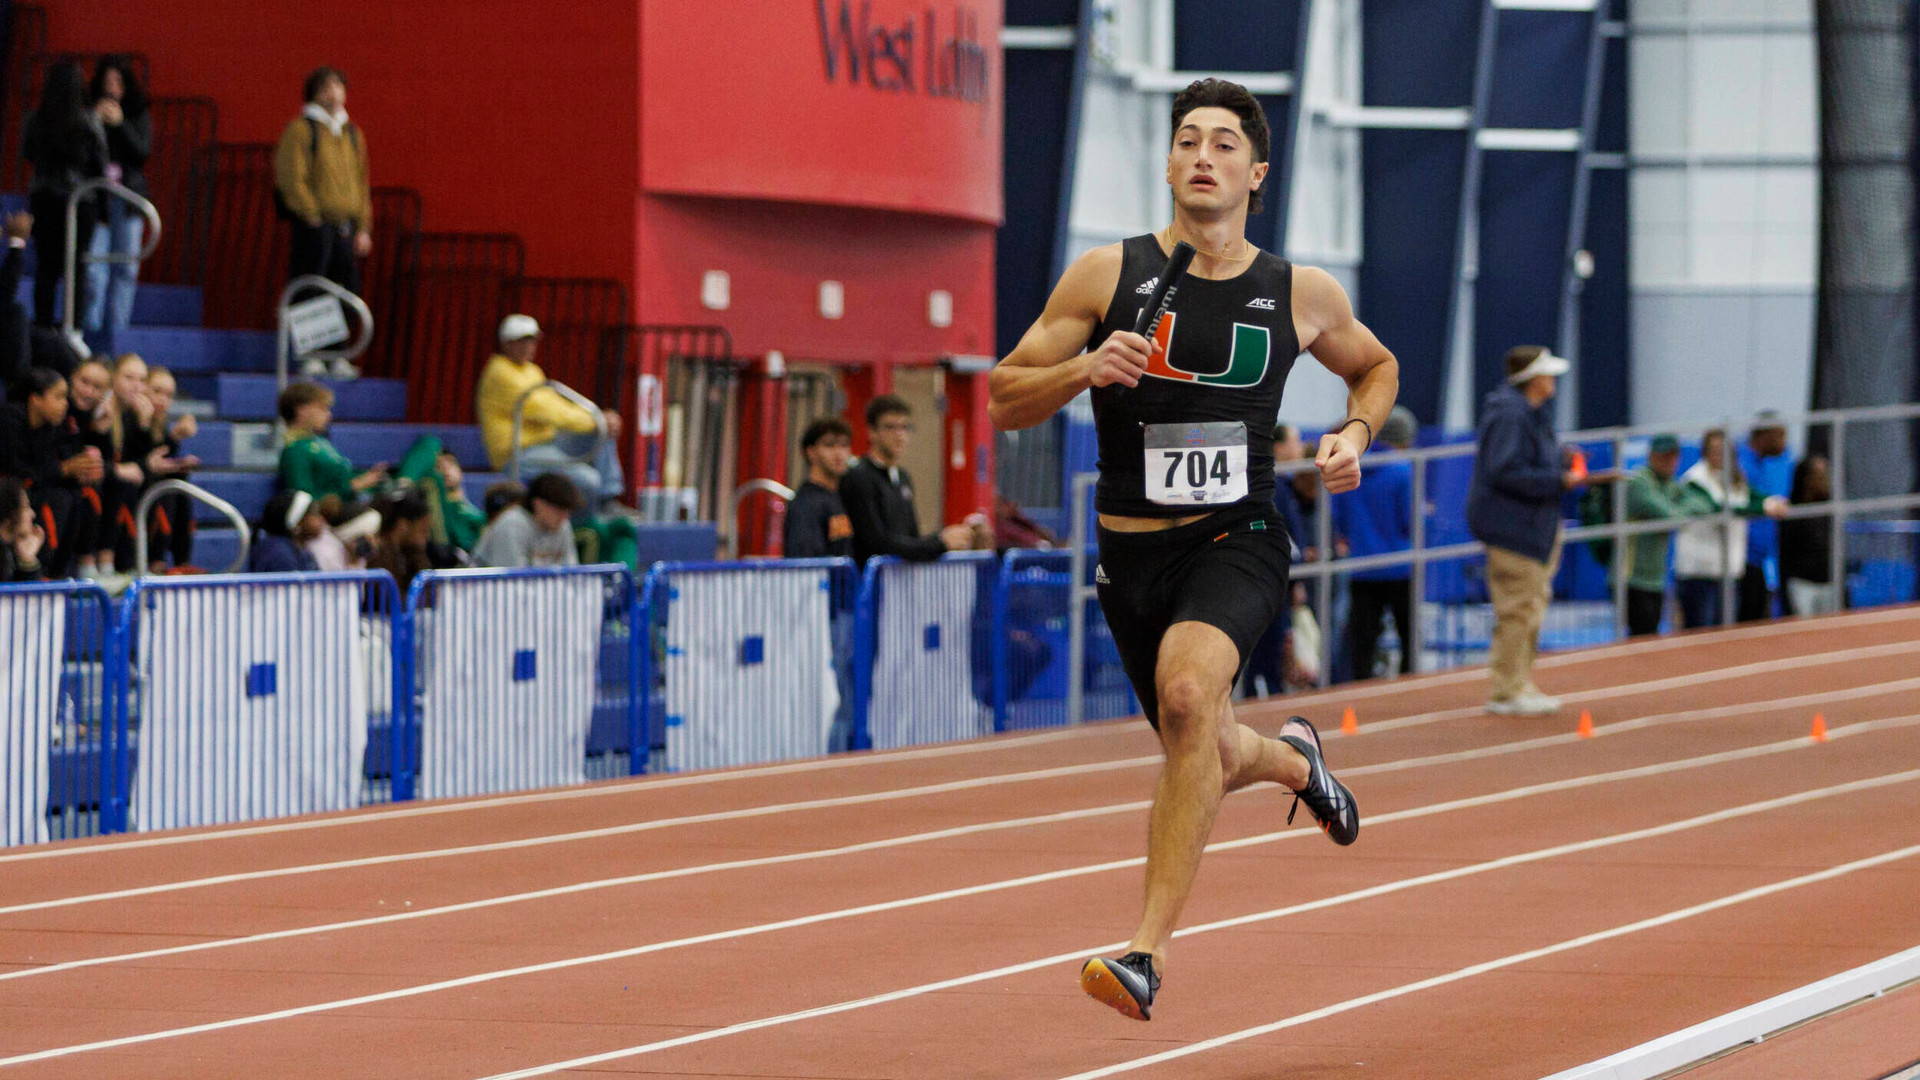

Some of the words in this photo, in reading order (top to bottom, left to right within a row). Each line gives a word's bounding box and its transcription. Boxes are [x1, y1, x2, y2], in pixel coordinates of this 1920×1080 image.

[815, 0, 914, 92] West
[1145, 285, 1178, 340] miami
[1248, 297, 1276, 308] ACC
[1163, 449, 1231, 488] 704
